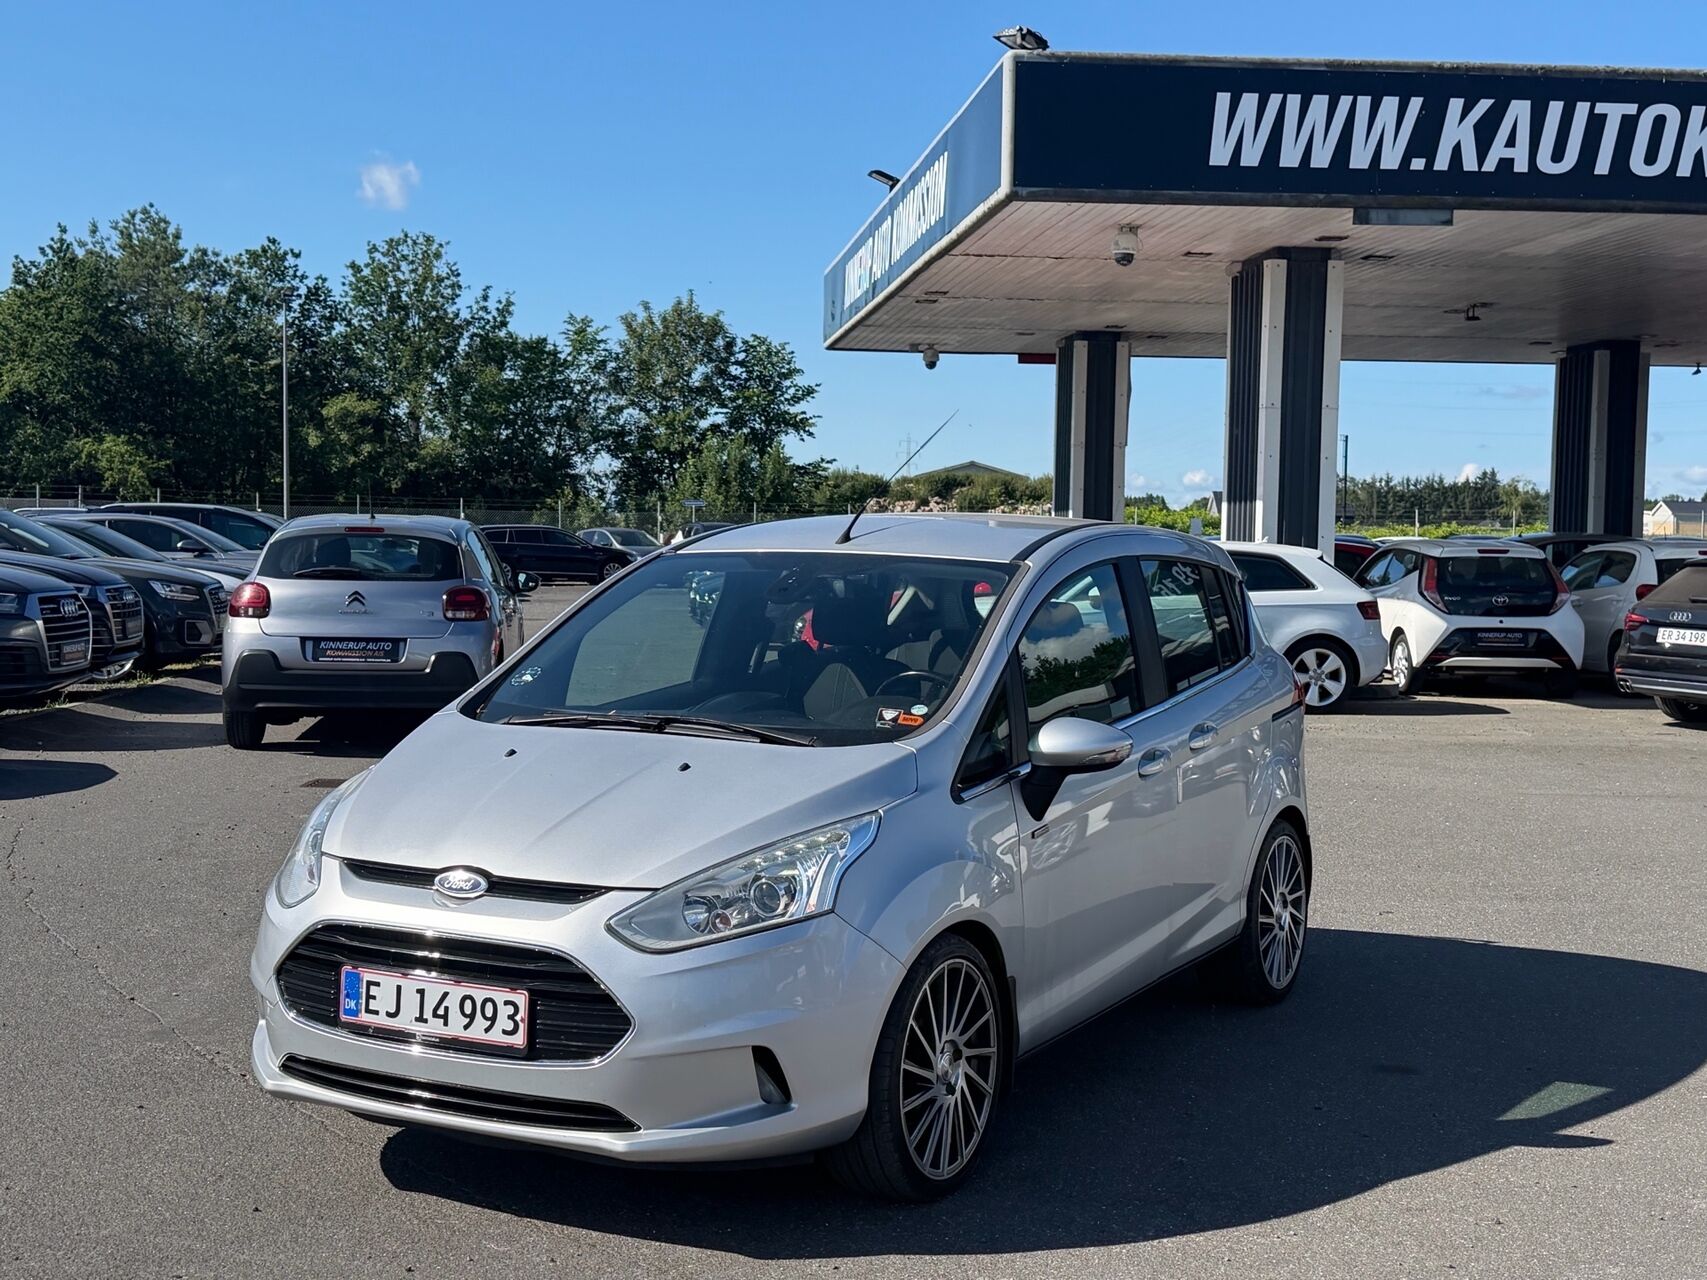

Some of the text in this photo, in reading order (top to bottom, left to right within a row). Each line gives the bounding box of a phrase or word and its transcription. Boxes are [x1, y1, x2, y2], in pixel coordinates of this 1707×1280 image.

[1661, 630, 1706, 643] ER 34 198
[320, 641, 392, 650] KINNERUP AUTO
[441, 874, 475, 890] Ford
[344, 998, 357, 1010] DK
[364, 980, 520, 1036] EJ 14 993
